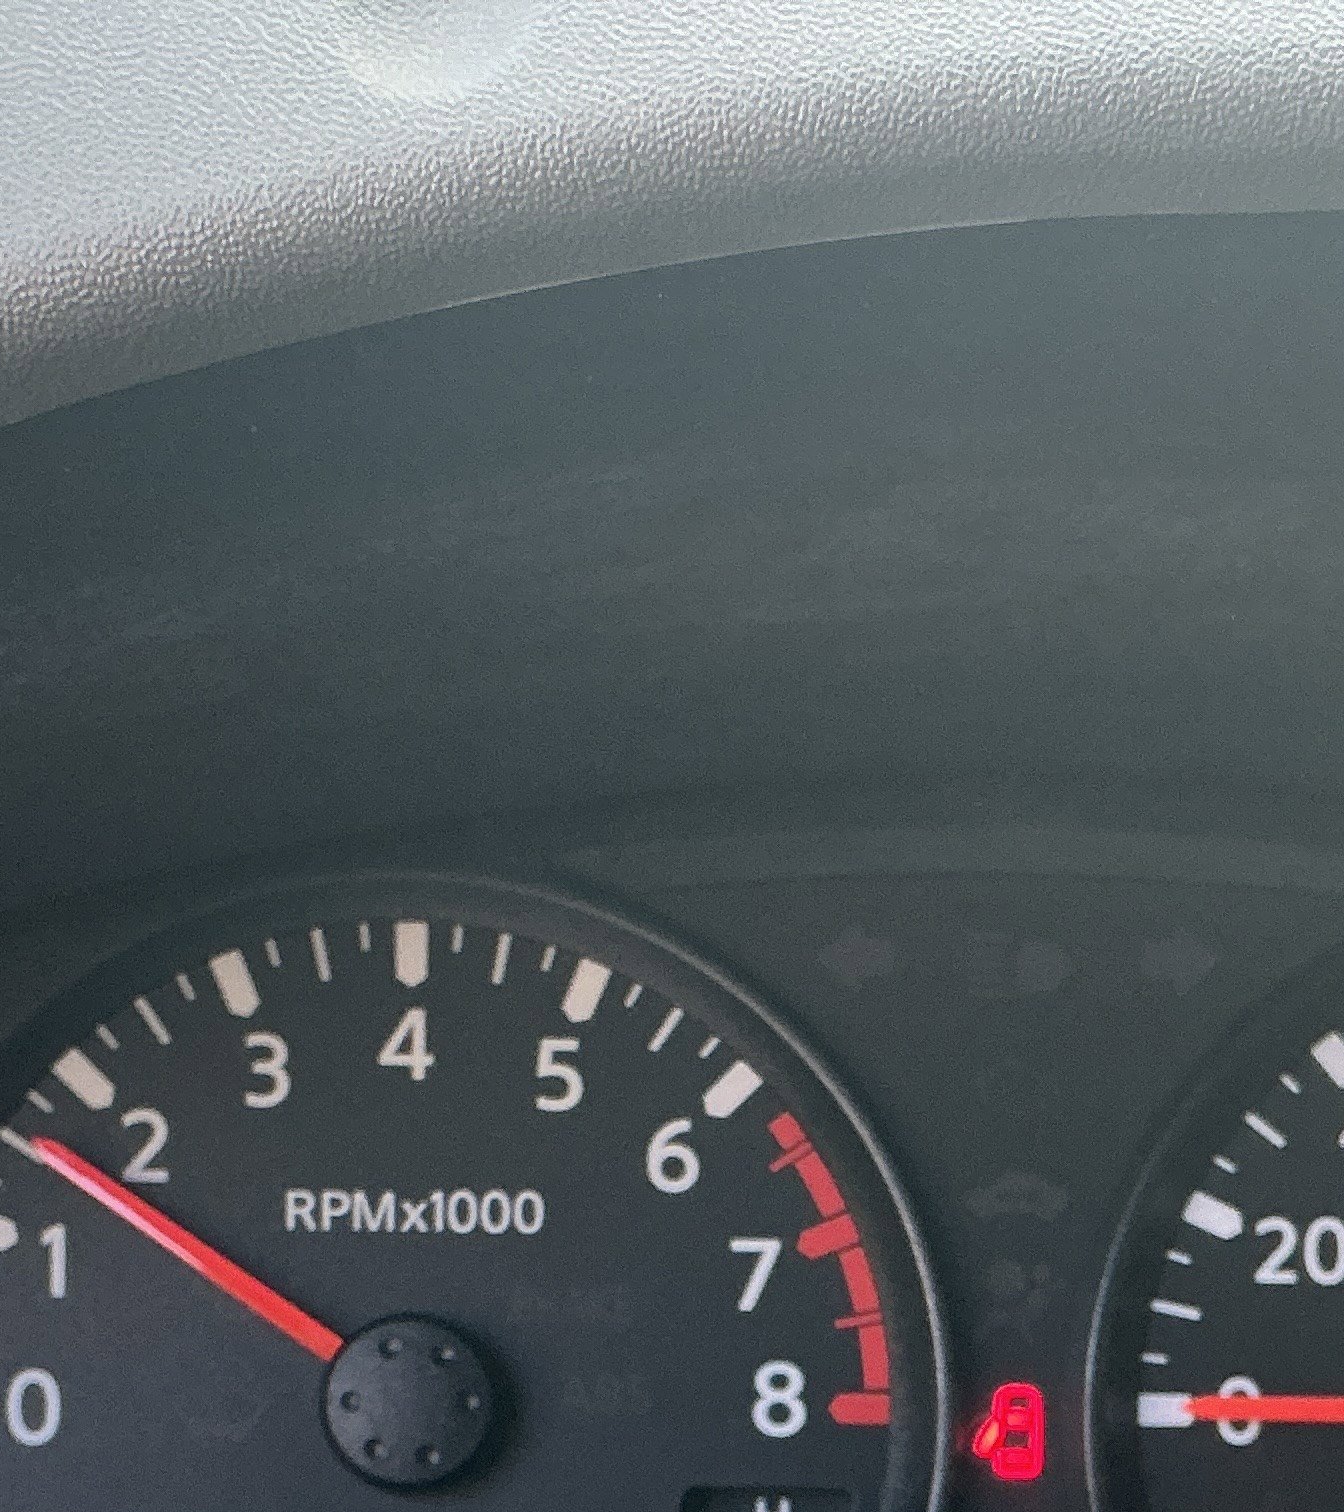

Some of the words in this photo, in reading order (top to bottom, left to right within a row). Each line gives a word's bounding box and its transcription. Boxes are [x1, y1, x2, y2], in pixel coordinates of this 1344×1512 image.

[245, 1033, 290, 1108] 3
[378, 1008, 435, 1081] 4
[536, 1038, 584, 1112] 5
[118, 1111, 170, 1184] 2
[646, 1118, 700, 1194] 6
[285, 1189, 545, 1235] RPMx1000
[41, 1224, 66, 1298] 1
[730, 1238, 782, 1312] 7
[6, 1368, 61, 1446] 0
[752, 1361, 807, 1438] 8
[1217, 1376, 1260, 1446] 0
